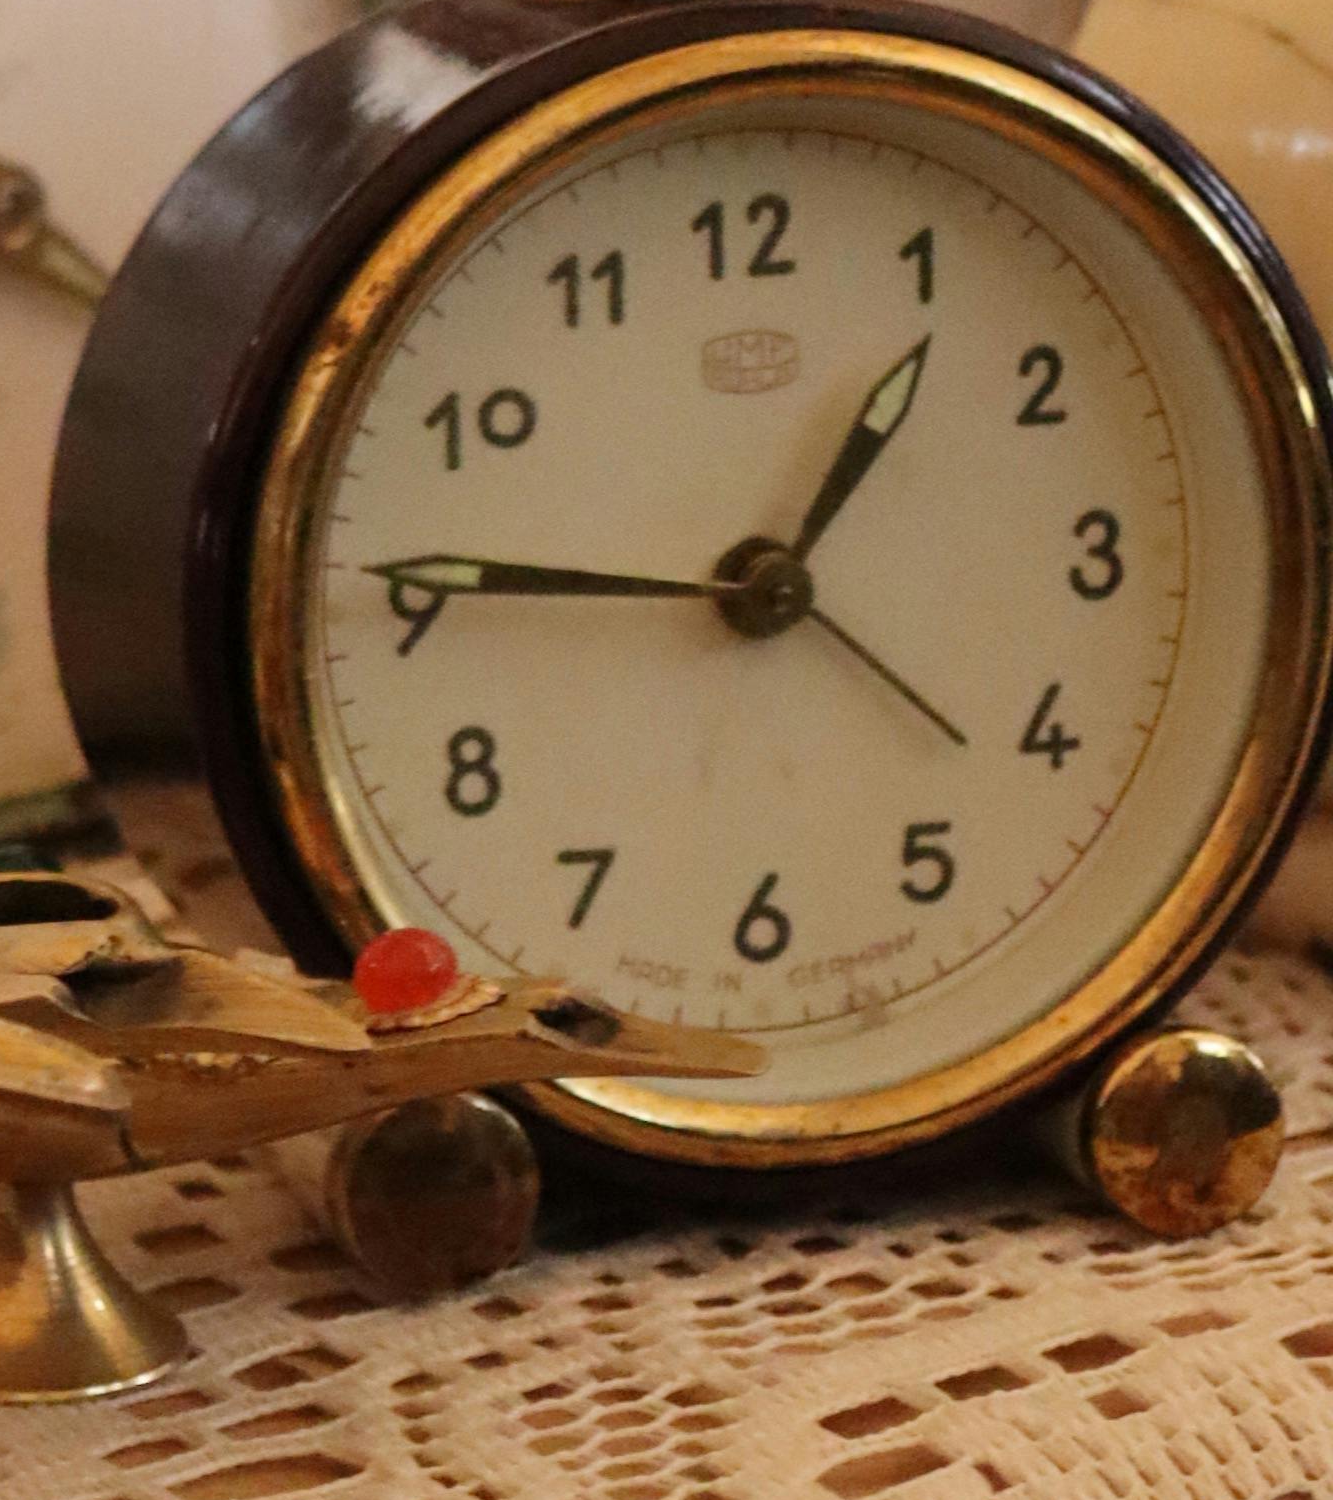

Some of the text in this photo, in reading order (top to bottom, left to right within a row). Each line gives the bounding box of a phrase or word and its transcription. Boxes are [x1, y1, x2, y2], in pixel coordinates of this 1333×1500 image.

[690, 194, 796, 279] 12
[899, 227, 935, 303] 1
[546, 250, 627, 327] 11
[1016, 345, 1068, 426] 2
[424, 388, 535, 471] 10
[1069, 510, 1124, 600] 3
[386, 558, 450, 657] 9
[1018, 684, 1081, 768] 4
[444, 726, 502, 815] 8
[556, 849, 614, 928] 7
[900, 821, 954, 903] 5
[734, 872, 791, 962] 6
